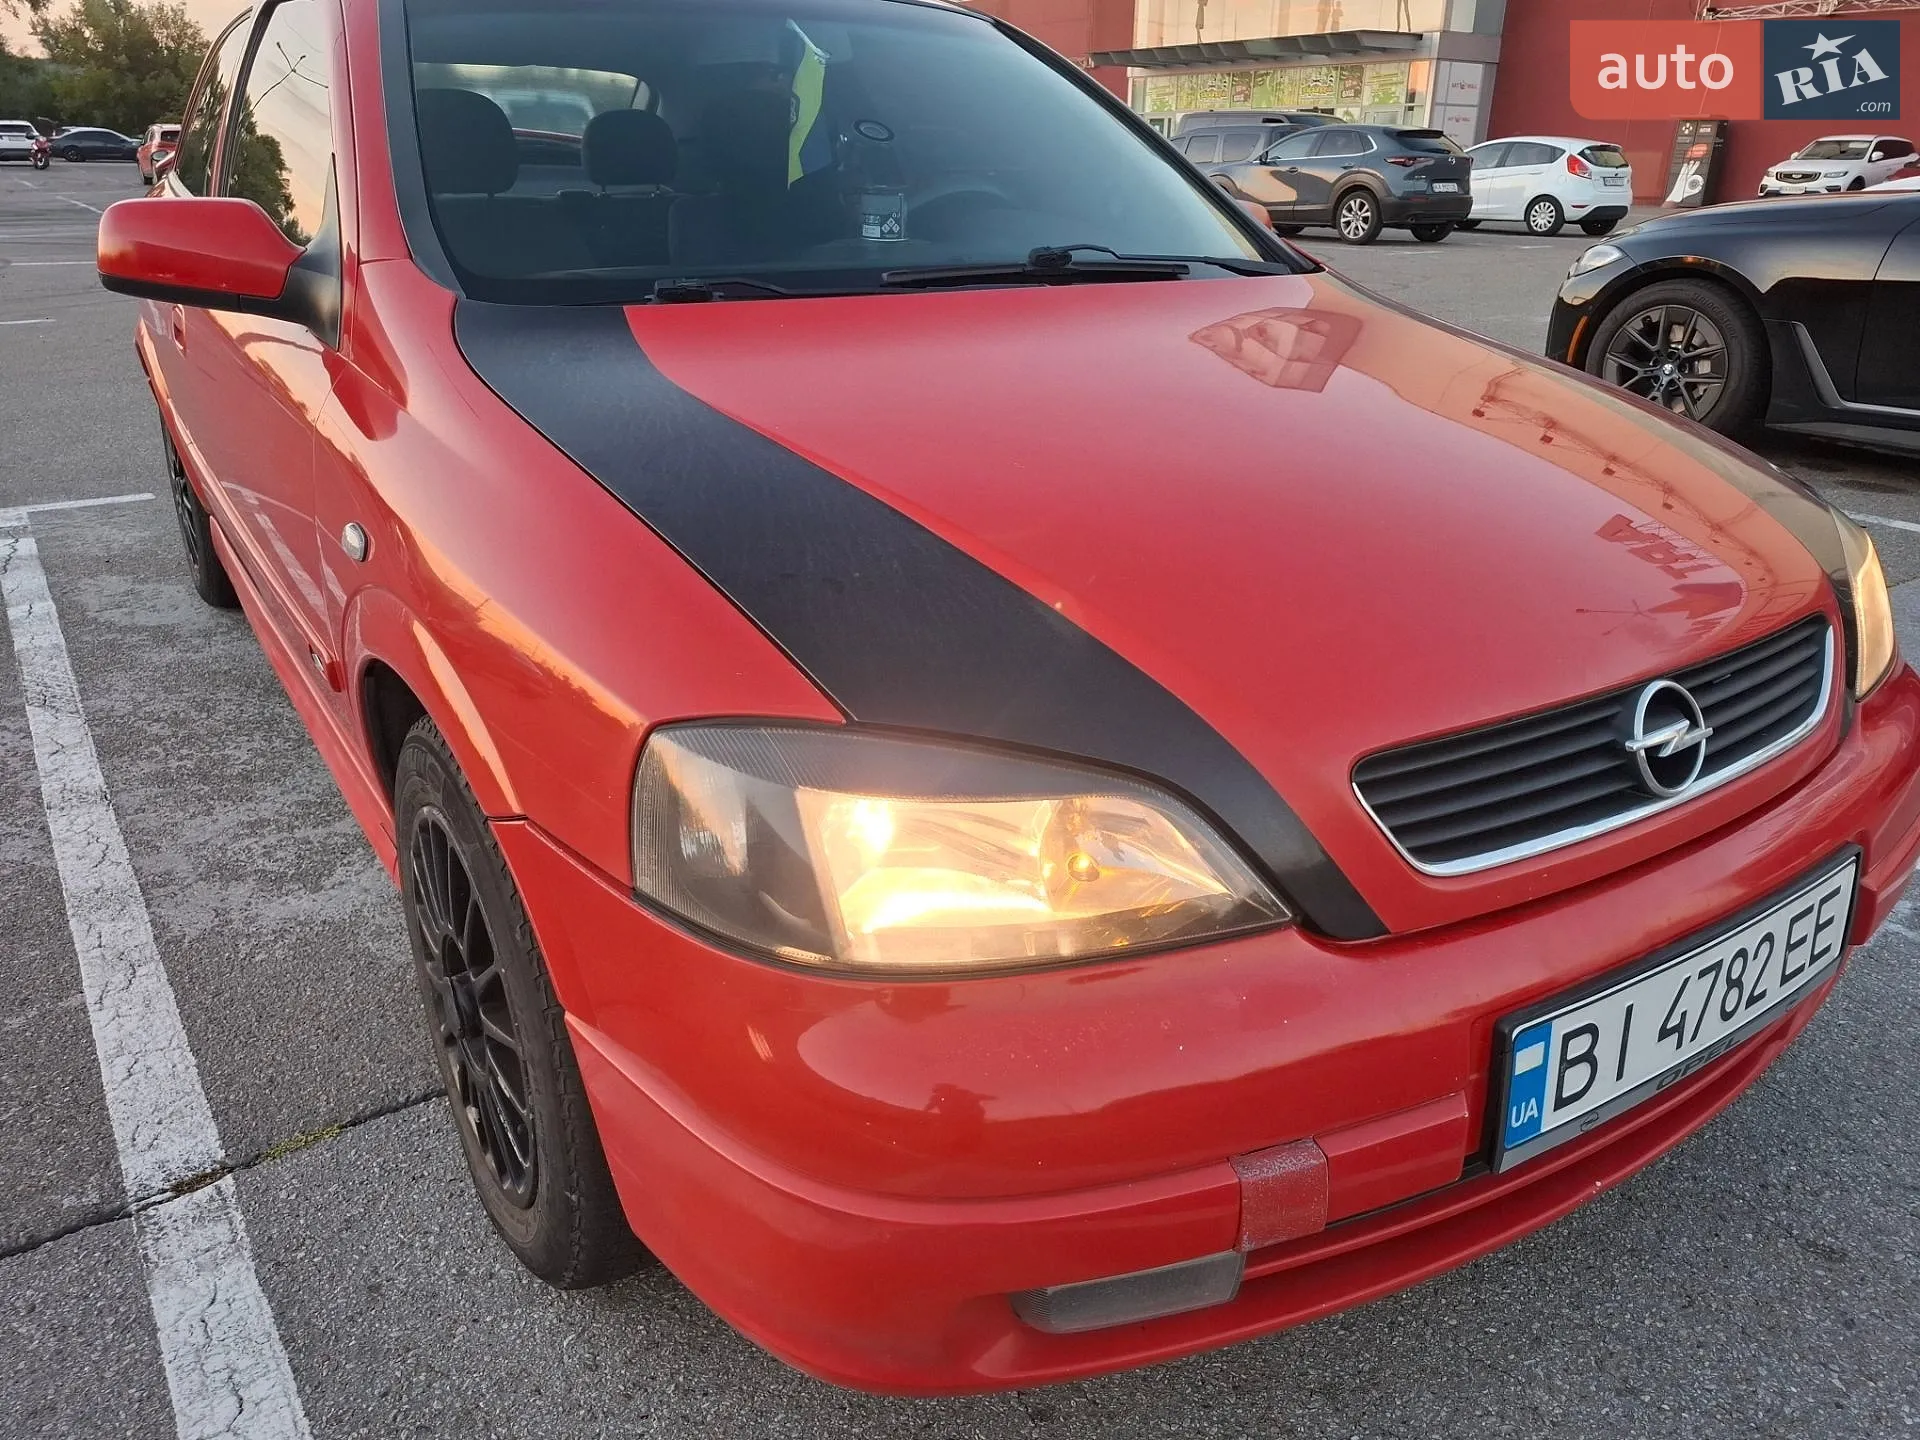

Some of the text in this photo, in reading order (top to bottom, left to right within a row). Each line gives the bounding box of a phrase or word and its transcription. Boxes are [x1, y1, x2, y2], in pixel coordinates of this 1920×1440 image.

[1553, 1003, 1634, 1113] BI
[1656, 1035, 1741, 1091] OPEL
[1511, 1096, 1539, 1128] UA
